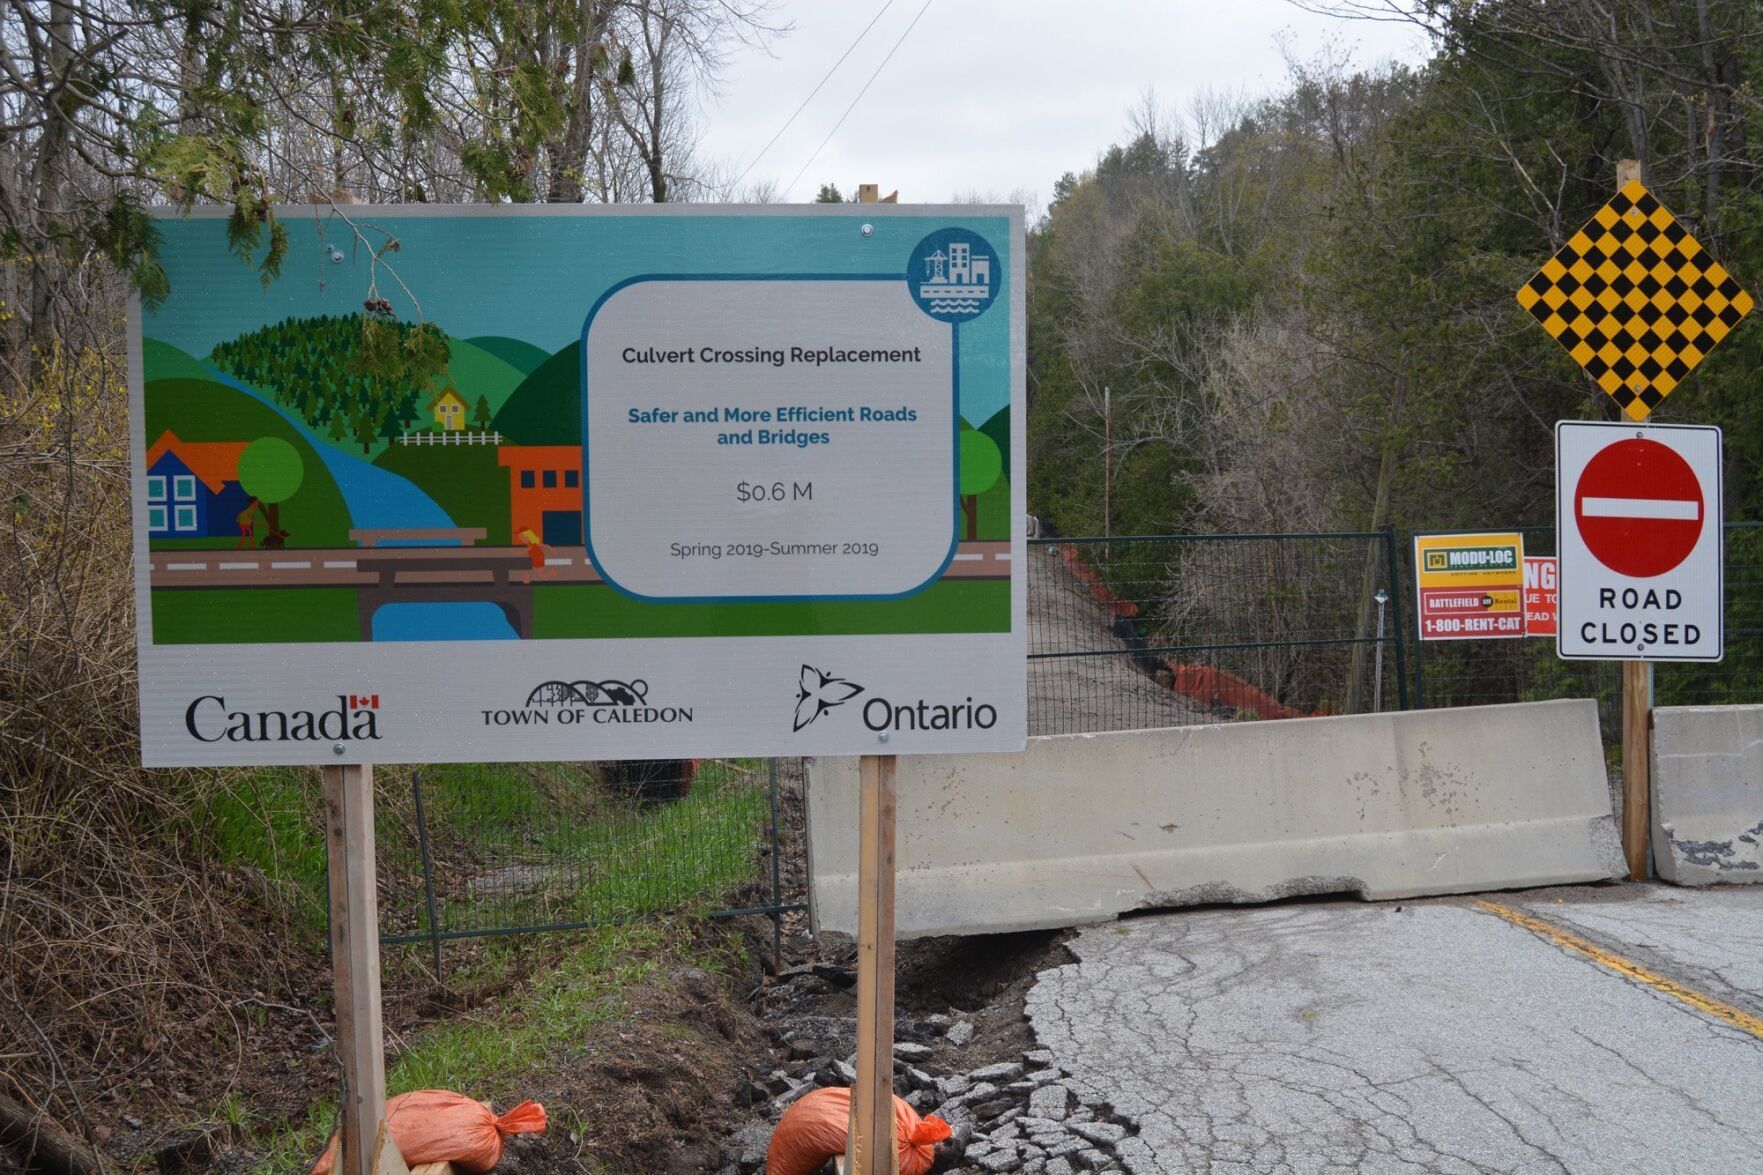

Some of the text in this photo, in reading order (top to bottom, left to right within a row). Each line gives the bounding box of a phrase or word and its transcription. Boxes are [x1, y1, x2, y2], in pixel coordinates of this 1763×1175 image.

[622, 347, 922, 366] Culvert Crossing Replacement
[628, 407, 917, 423] Safer and More Efficient Roads
[717, 429, 830, 448] and Bridges
[736, 481, 812, 503] $0.6 M
[670, 542, 879, 559] Spring 2019-Summer 2019
[1450, 550, 1512, 565] MODU-LOC
[1524, 562, 1556, 589] NG
[1429, 598, 1479, 608] BATTLEFIELD
[1525, 593, 1540, 604] UE
[1600, 588, 1682, 610] ROAD
[1425, 617, 1521, 632] 1-800-RENT-CAT
[1526, 612, 1550, 621] EAD
[1581, 622, 1701, 645] CLOSED
[185, 695, 383, 743] Canada
[482, 707, 693, 726] TOWN OF CALEDON
[862, 697, 998, 731] Ontario
